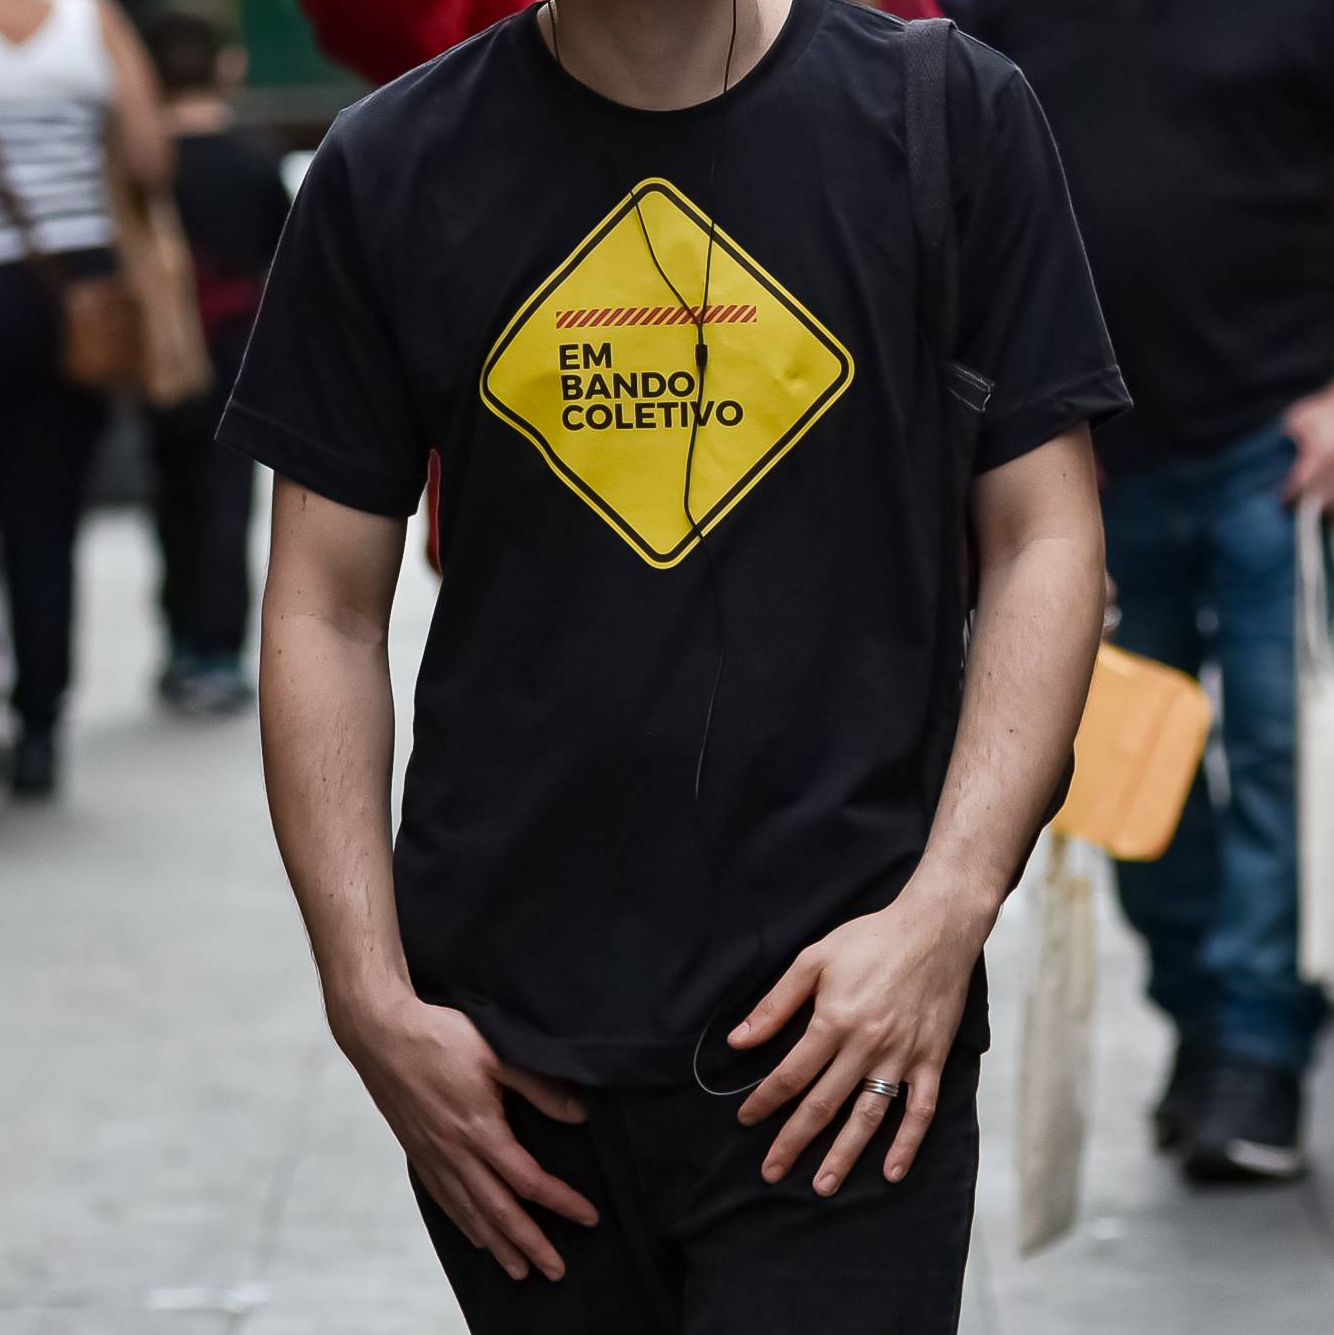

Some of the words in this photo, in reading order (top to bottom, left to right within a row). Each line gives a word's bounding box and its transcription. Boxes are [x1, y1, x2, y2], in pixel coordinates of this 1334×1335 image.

[559, 342, 612, 371] EM
[560, 371, 696, 401] BANDO
[561, 400, 744, 432] COLETIVO
